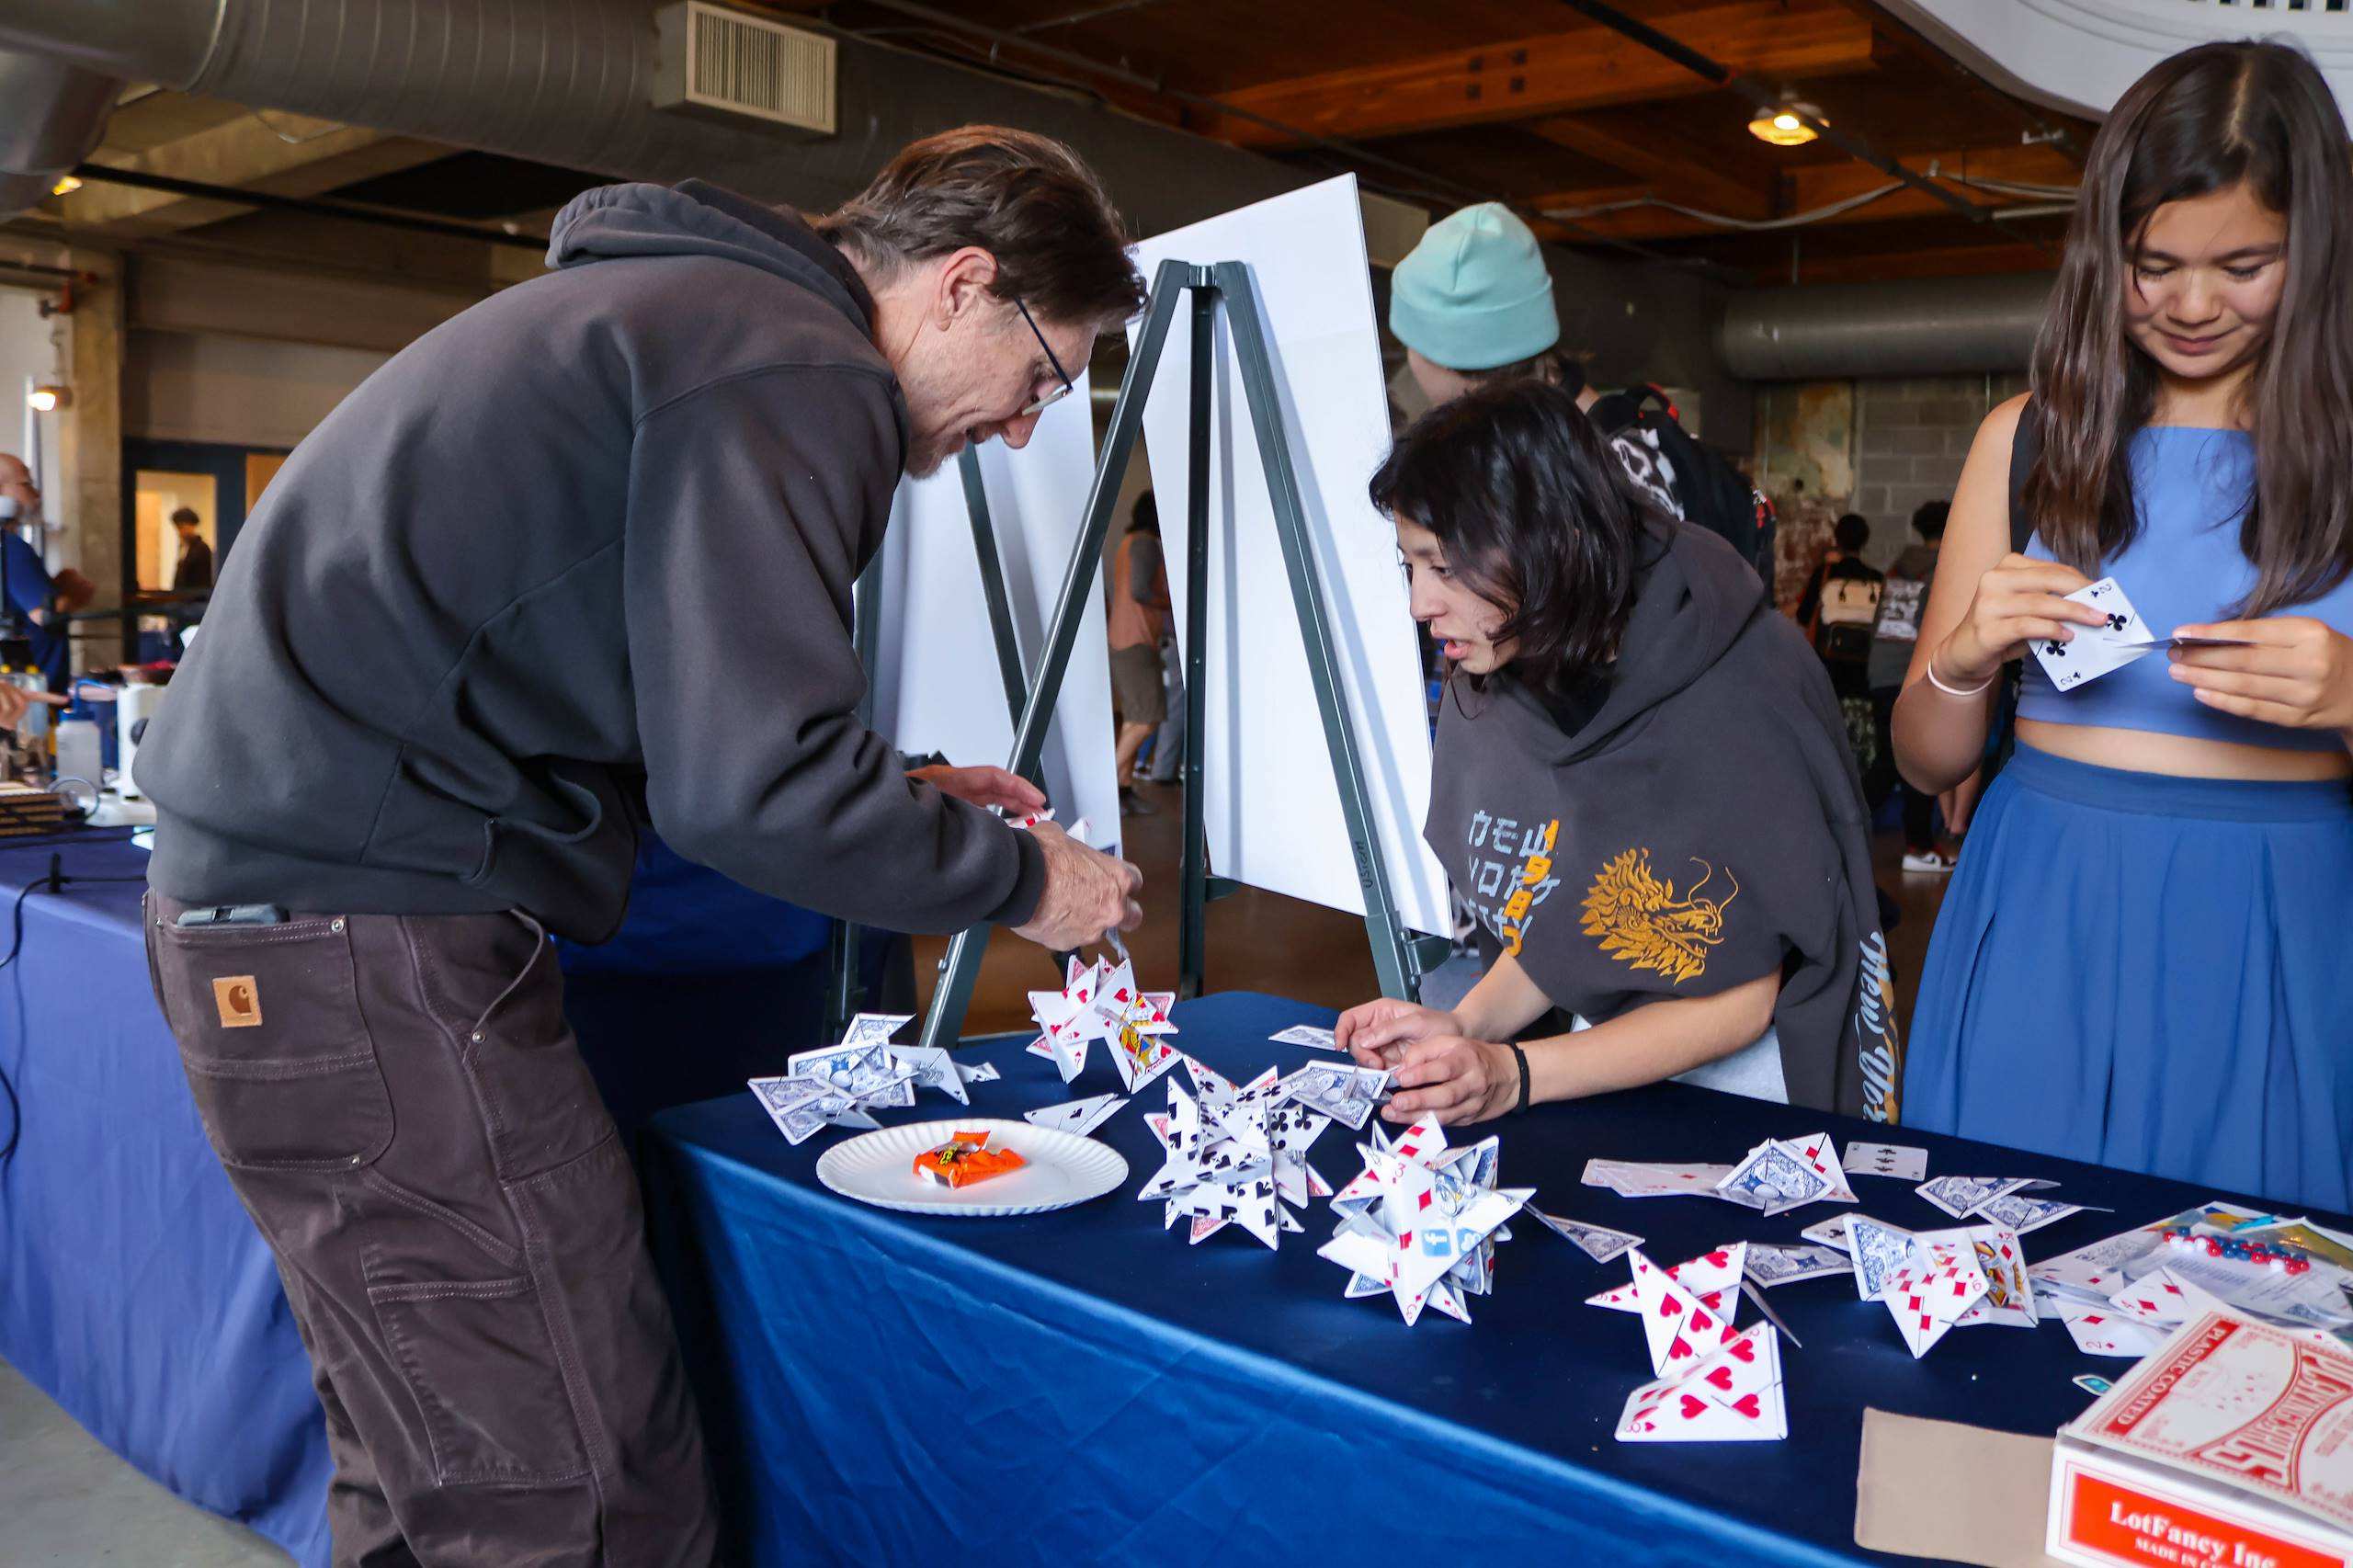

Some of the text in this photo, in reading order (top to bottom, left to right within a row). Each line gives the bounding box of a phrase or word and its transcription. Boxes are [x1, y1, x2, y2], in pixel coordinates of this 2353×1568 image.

[1855, 1022, 1894, 1123] Yor
[2116, 1326, 2226, 1426] PLASTIC COATED
[2110, 1500, 2226, 1562] LotFancy
[2134, 1536, 2178, 1562] MADE
